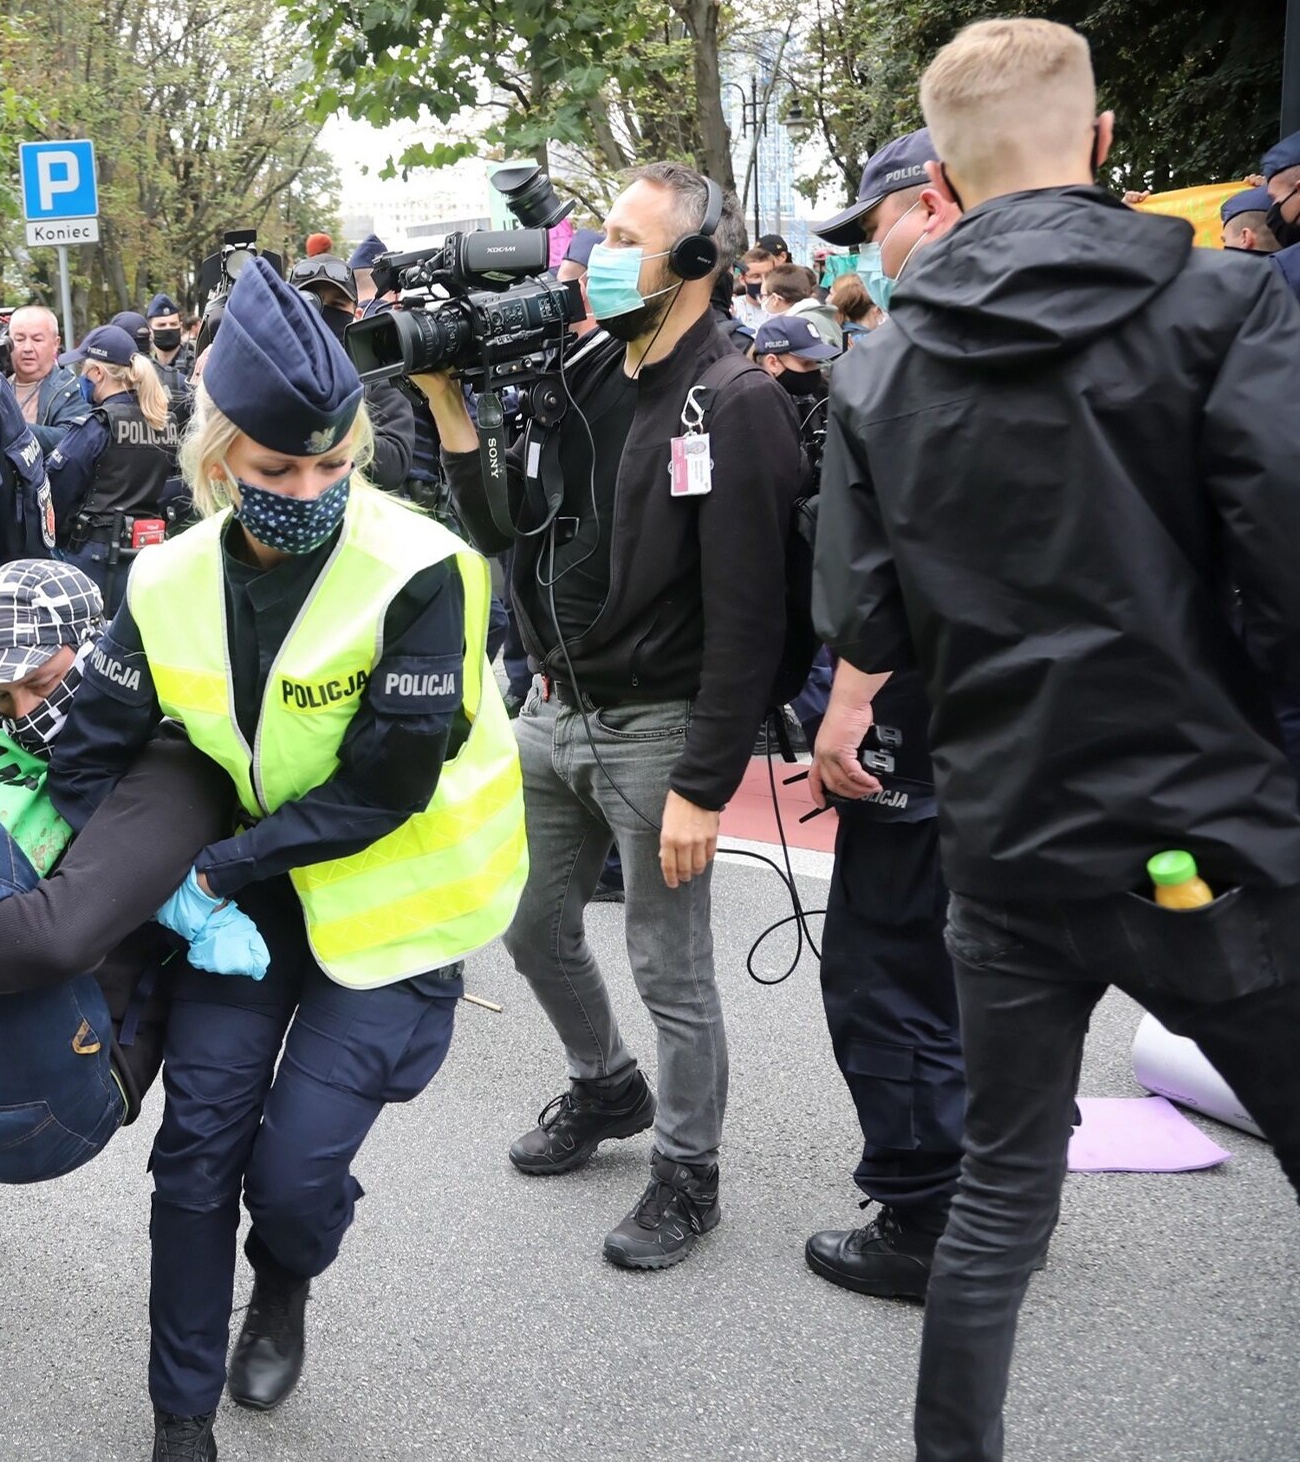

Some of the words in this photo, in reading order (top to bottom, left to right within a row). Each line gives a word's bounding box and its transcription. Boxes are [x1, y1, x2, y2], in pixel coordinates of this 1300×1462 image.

[36, 150, 80, 211] P
[885, 164, 927, 184] POLIC
[34, 225, 90, 241] Koniec
[764, 339, 790, 349] POLICJA
[488, 437, 500, 479] SONY
[90, 649, 141, 691] POLICJA
[384, 672, 456, 697] POLICJA
[282, 669, 368, 710] POLICJA
